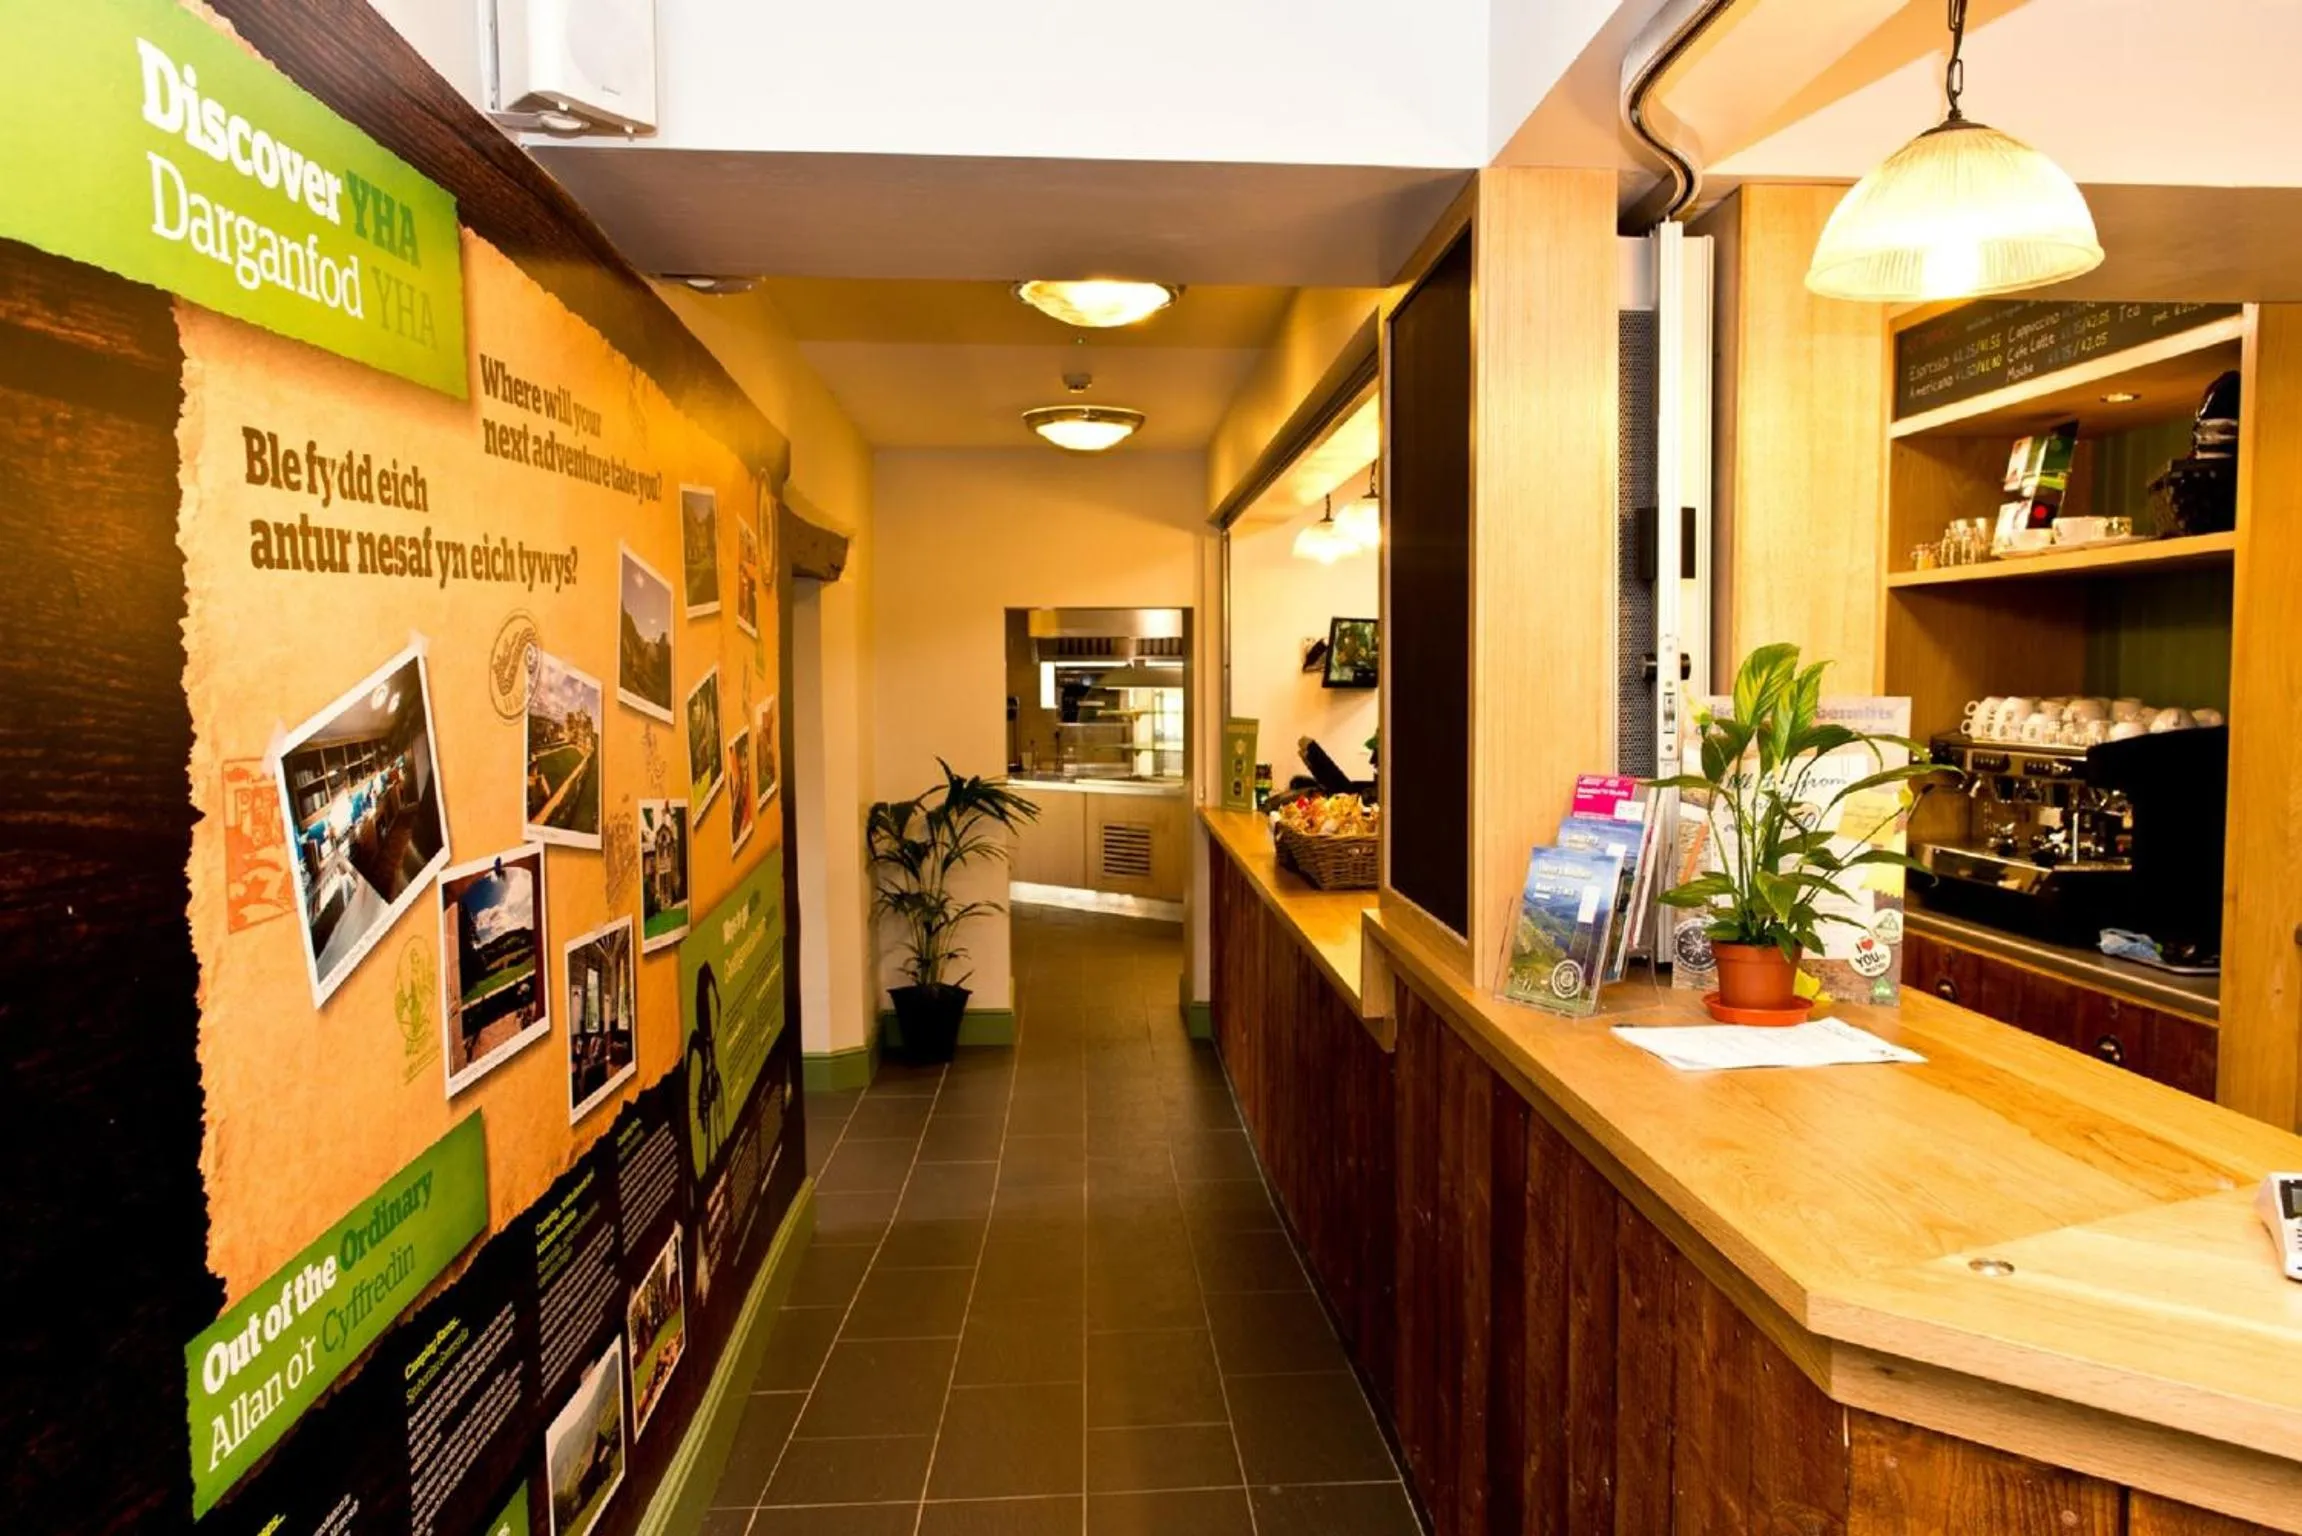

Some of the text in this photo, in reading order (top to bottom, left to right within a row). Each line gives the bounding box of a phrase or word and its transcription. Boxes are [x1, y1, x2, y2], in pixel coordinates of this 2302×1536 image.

[136, 37, 421, 269] Discover YHA
[147, 151, 438, 350] Darganfod YHA
[480, 353, 602, 438] Where will your
[242, 426, 429, 512] Ble fydd eich
[483, 418, 662, 505] next adventure take you?
[250, 513, 578, 593] antur nesaf yn eich tywys?
[1799, 770, 1847, 798] from
[1855, 952, 1880, 967] YOU
[202, 1170, 433, 1395] Out of the Ordinary
[209, 1369, 284, 1472] Allan
[286, 1336, 317, 1390] o'r
[321, 1243, 415, 1353] Cyffredin
